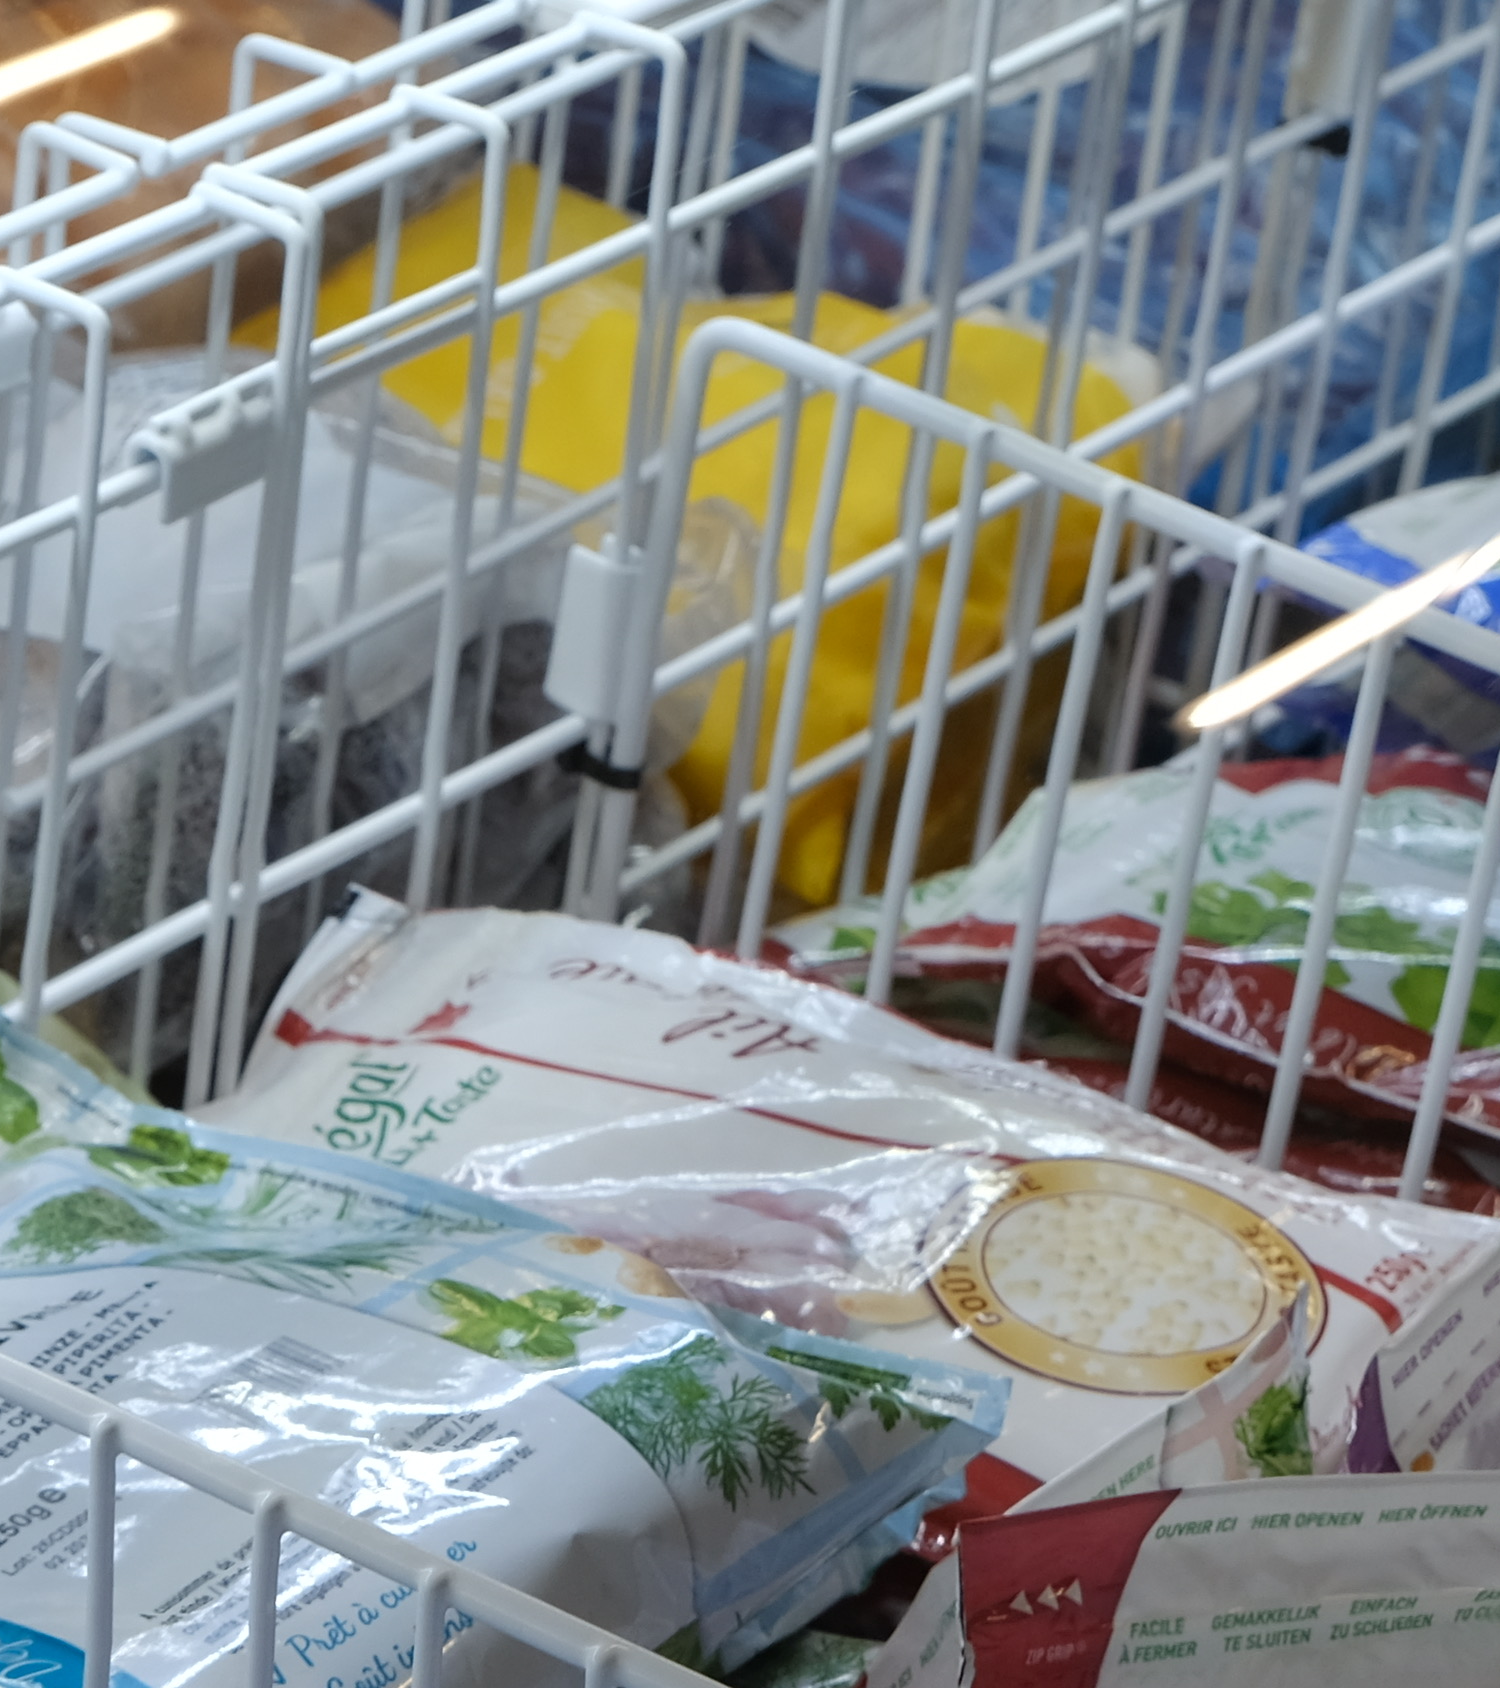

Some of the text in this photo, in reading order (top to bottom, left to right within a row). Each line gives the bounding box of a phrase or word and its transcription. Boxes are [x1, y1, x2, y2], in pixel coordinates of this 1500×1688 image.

[52, 1308, 143, 1376] PIPERITA
[79, 1314, 166, 1379] PIMENTA
[1155, 1519, 1214, 1541] OUVRIR
[1215, 1516, 1240, 1534] ICI
[1251, 1514, 1292, 1532] HIER
[1294, 1511, 1365, 1530] OPENEN
[1377, 1507, 1416, 1524] HIER
[1419, 1502, 1488, 1521] ÖFFNEN
[1210, 1603, 1321, 1633] GEMAKKELIJK
[1348, 1597, 1420, 1617] EINFACH
[285, 1599, 378, 1669] Prêt à
[1129, 1617, 1186, 1640] FACILE
[1223, 1627, 1313, 1653] TE SLUITEN
[1329, 1624, 1351, 1642] ZU
[1118, 1641, 1199, 1666] À FERMER
